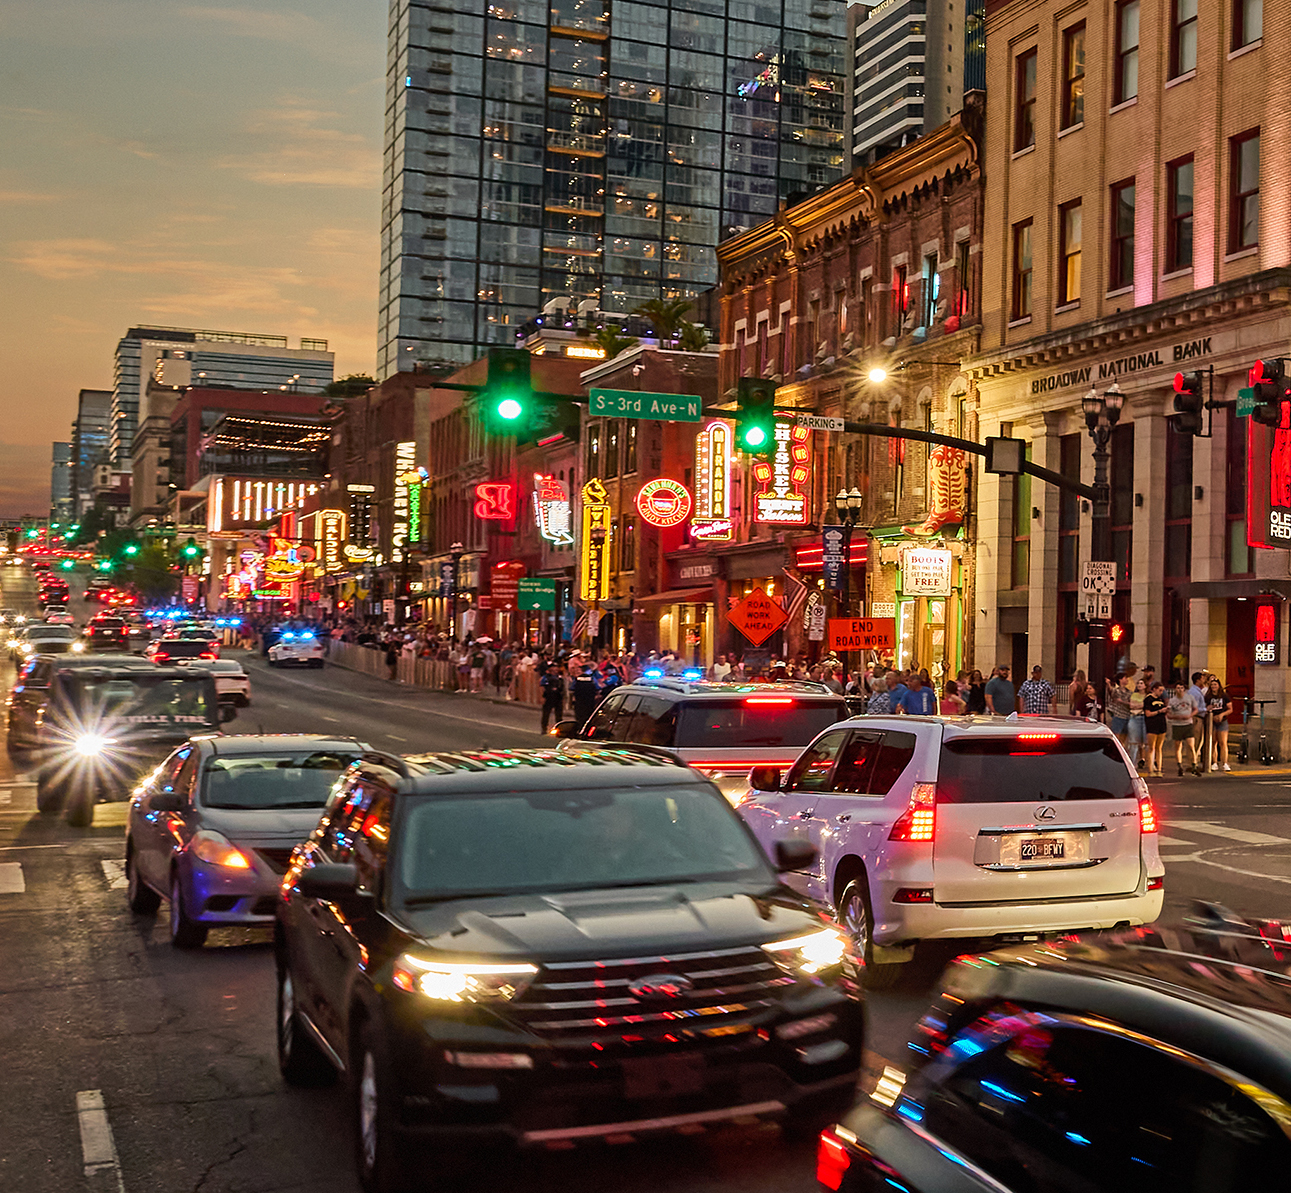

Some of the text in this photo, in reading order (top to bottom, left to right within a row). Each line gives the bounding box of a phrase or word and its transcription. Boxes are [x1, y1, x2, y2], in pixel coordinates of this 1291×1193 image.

[1031, 337, 1212, 394] BROADWAY NATIONAL BANK
[798, 416, 835, 429] PARKING
[714, 430, 726, 515] MIRANDA
[640, 503, 688, 525] CANDY KITCHEN
[1270, 511, 1291, 526] OLE
[1270, 524, 1291, 540] RED
[911, 556, 944, 564] BOOTS
[914, 578, 940, 586] FREE
[1083, 576, 1096, 589] OK
[747, 601, 771, 609] ROAD
[747, 612, 771, 620] WORK
[744, 623, 773, 631] AHEAD
[852, 621, 873, 633] END
[836, 635, 889, 647] ROAD WORK
[1255, 643, 1275, 653] OLE
[1255, 652, 1275, 662] RED
[1022, 844, 1037, 856] 220
